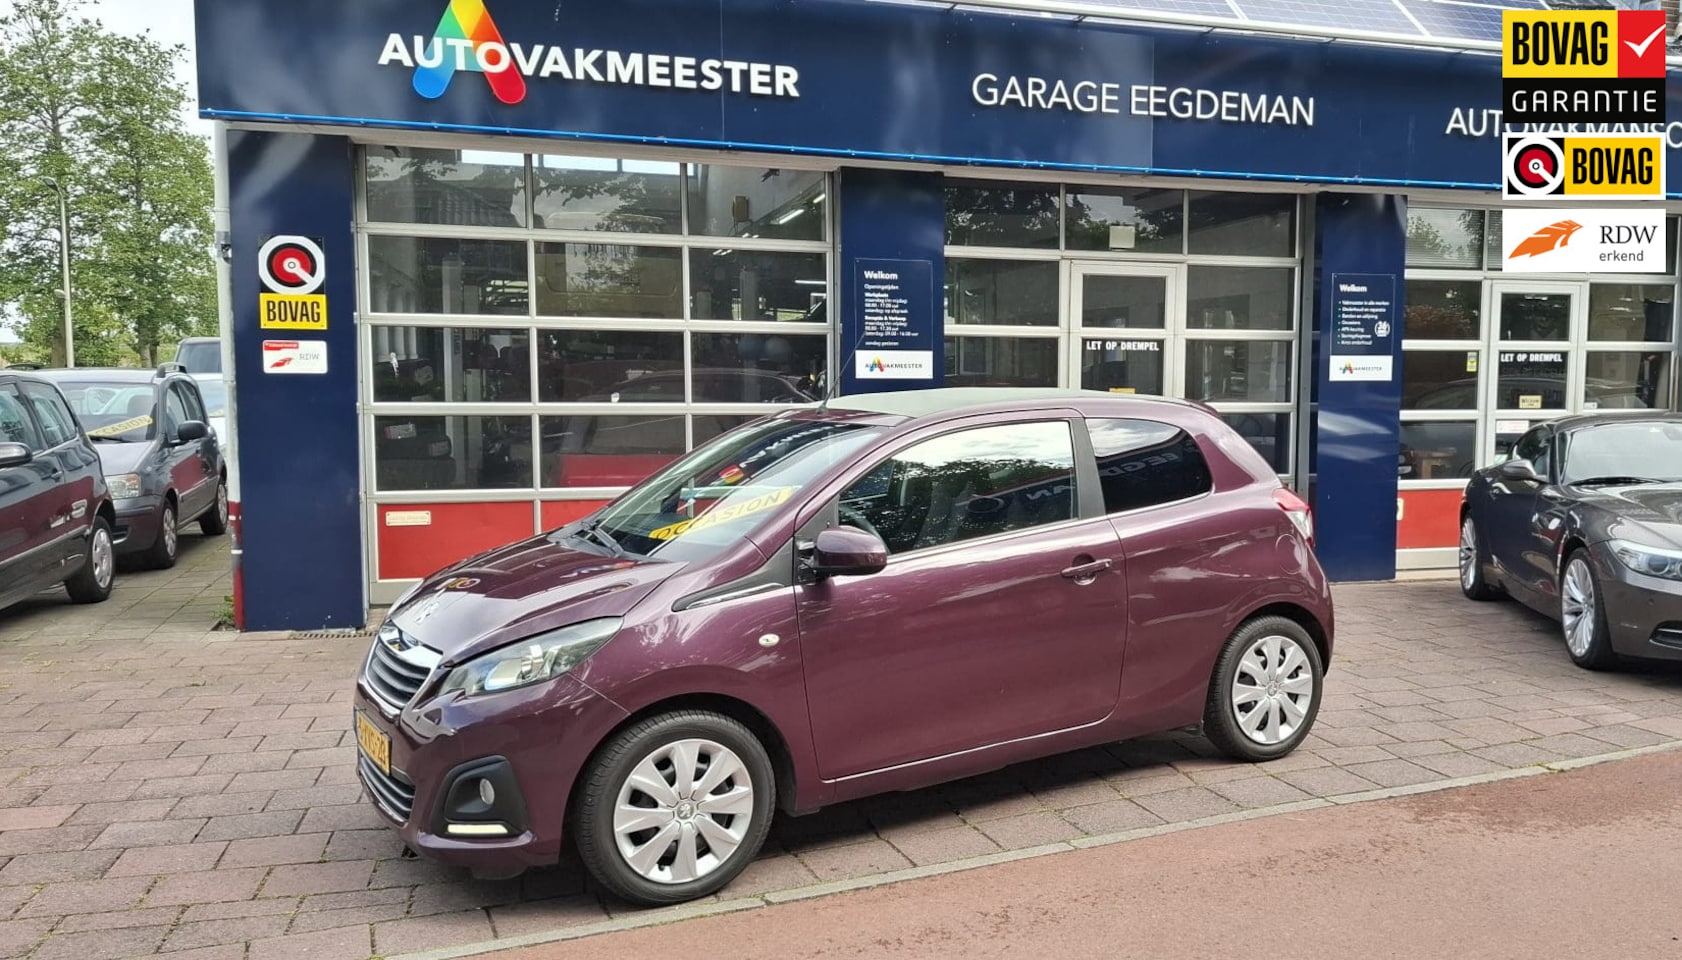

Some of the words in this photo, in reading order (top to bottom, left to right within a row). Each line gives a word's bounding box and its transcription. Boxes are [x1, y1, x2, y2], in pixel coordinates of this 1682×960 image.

[378, 33, 801, 97] AUTOVAKMEESTER
[972, 73, 1120, 114] GARAGE
[1130, 85, 1315, 126] EEGDEMAN
[864, 270, 898, 280] Welkom
[1339, 284, 1367, 293] Welkom
[266, 300, 321, 323] BOVAG
[1086, 341, 1102, 351] LET
[1105, 341, 1117, 351] OP
[1120, 341, 1160, 351] DREMPEL
[1500, 353, 1515, 362] LET
[1516, 353, 1528, 362] OP
[1529, 353, 1563, 362] DREMPEL
